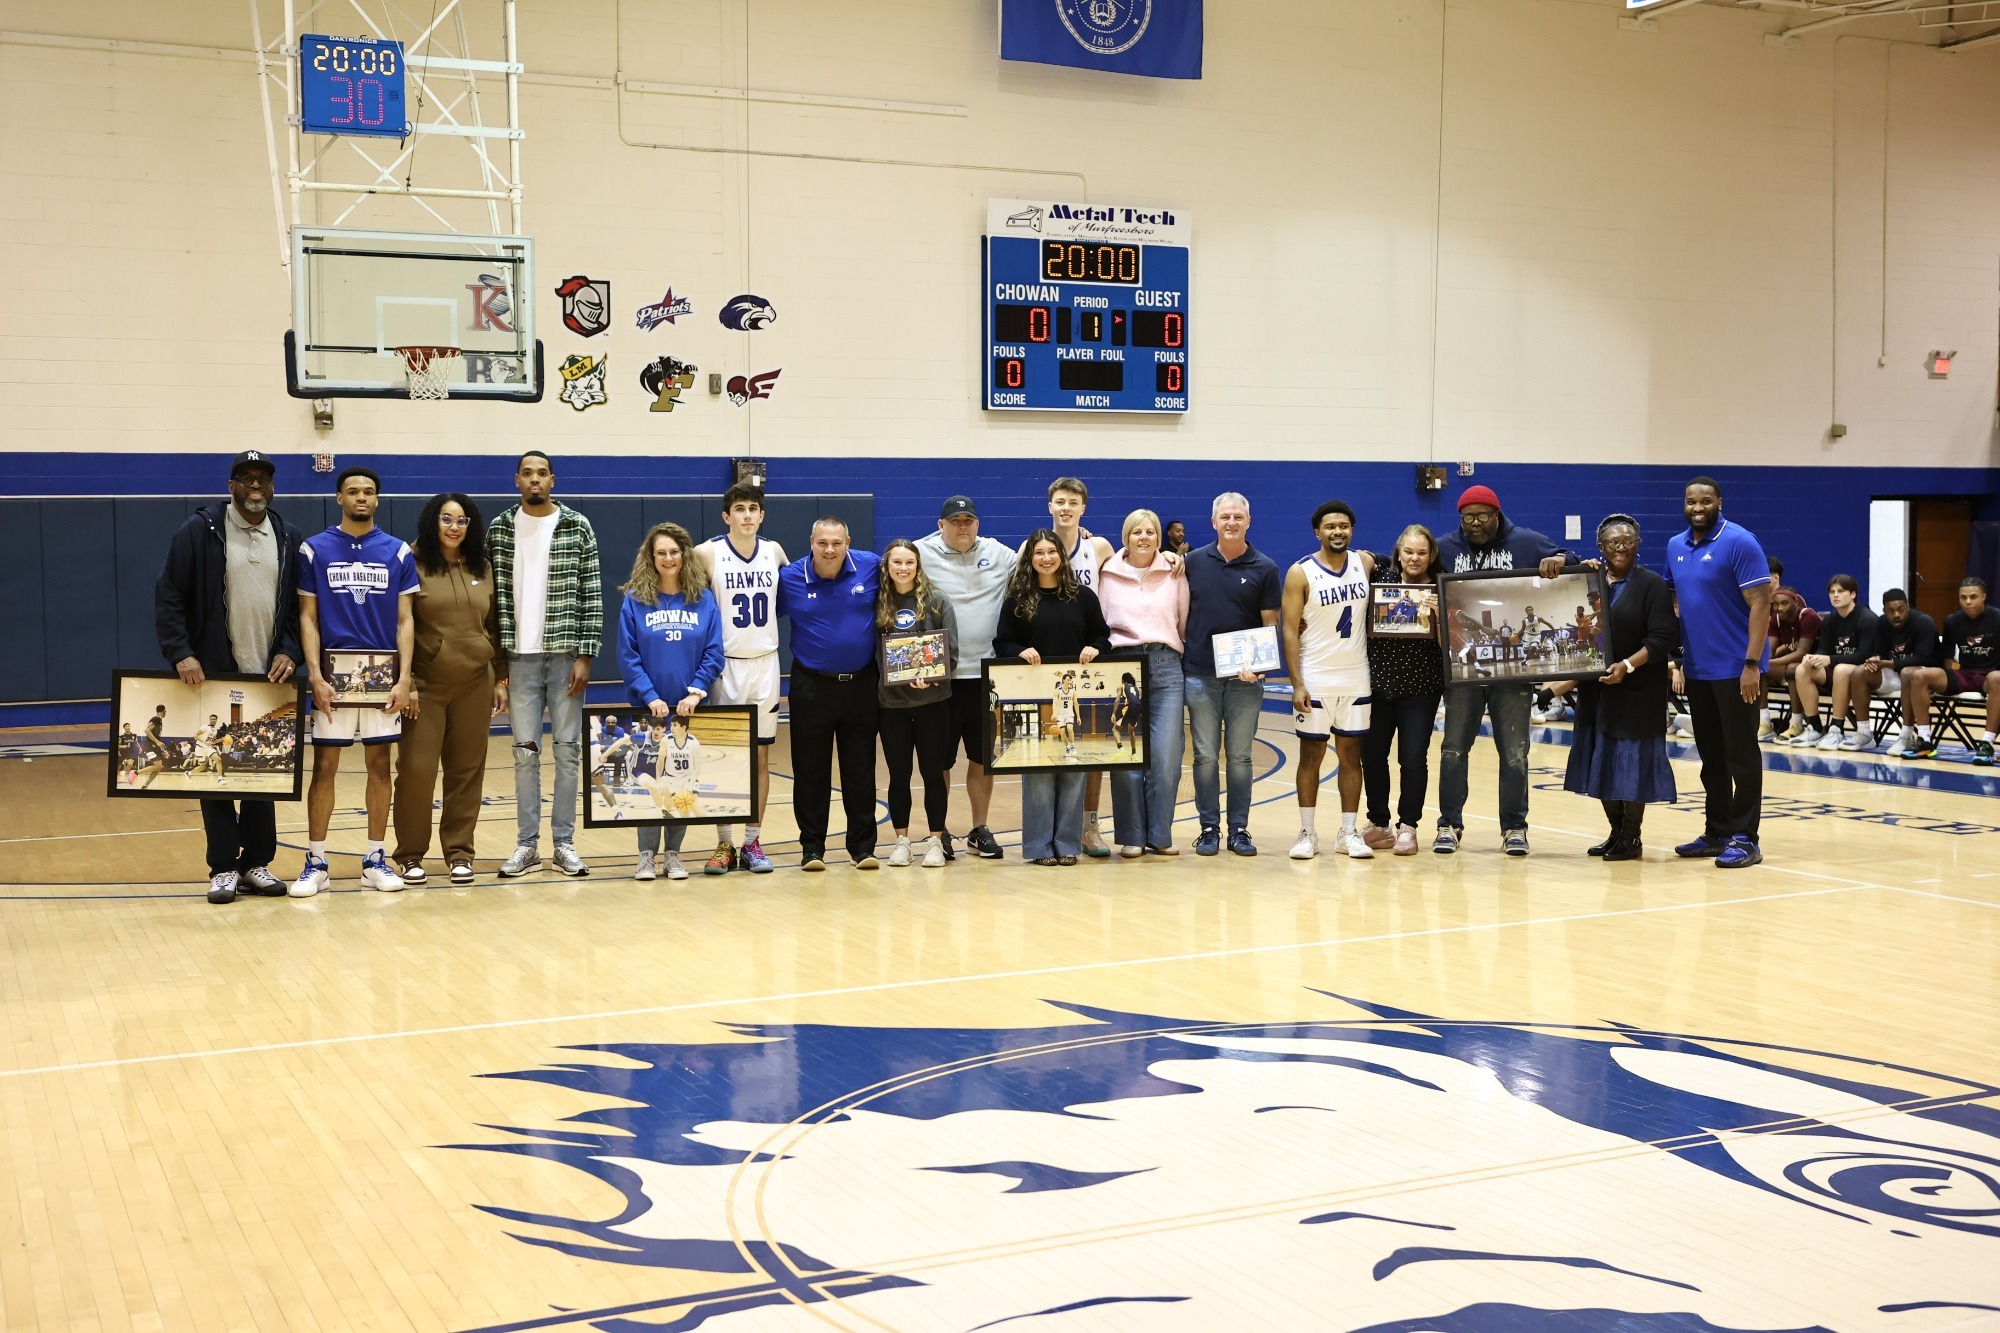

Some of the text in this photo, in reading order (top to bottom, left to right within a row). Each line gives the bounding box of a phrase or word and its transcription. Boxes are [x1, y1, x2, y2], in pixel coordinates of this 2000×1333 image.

[329, 35, 378, 44] DAKTRONICS
[1091, 35, 1114, 47] 1848
[313, 44, 396, 76] 20:00
[330, 76, 384, 126] 30
[1048, 204, 1175, 226] Metal Tech
[1068, 222, 1155, 235] of Murfreesboro
[1047, 244, 1136, 281] 20:00
[995, 283, 1060, 302] CHOWAN
[1135, 290, 1181, 308] GUEST
[1073, 296, 1109, 309] PERIOD
[637, 302, 691, 323] Patriots
[1029, 307, 1048, 342] 0
[1094, 316, 1099, 338] 1
[1164, 314, 1182, 346] 0
[993, 346, 1026, 358] FOULS
[1056, 348, 1125, 361] PLAYER FOUL
[1154, 351, 1185, 363] FOULS
[569, 362, 588, 377] LM
[1006, 360, 1021, 387] 0
[1167, 365, 1181, 391] 0
[993, 393, 1027, 405] SCORE
[1075, 395, 1110, 407] MATCH
[1154, 397, 1185, 409] SCORE
[329, 572, 387, 583] CHOWAN BASKETBALL
[725, 571, 773, 589] HAWKS
[1319, 582, 1366, 606] HAWKS
[645, 609, 699, 627] CHOWAN
[732, 592, 768, 628] 30
[1336, 605, 1352, 638] 4
[665, 630, 682, 642] 30
[1063, 701, 1069, 709] 5
[674, 760, 689, 770] 30
